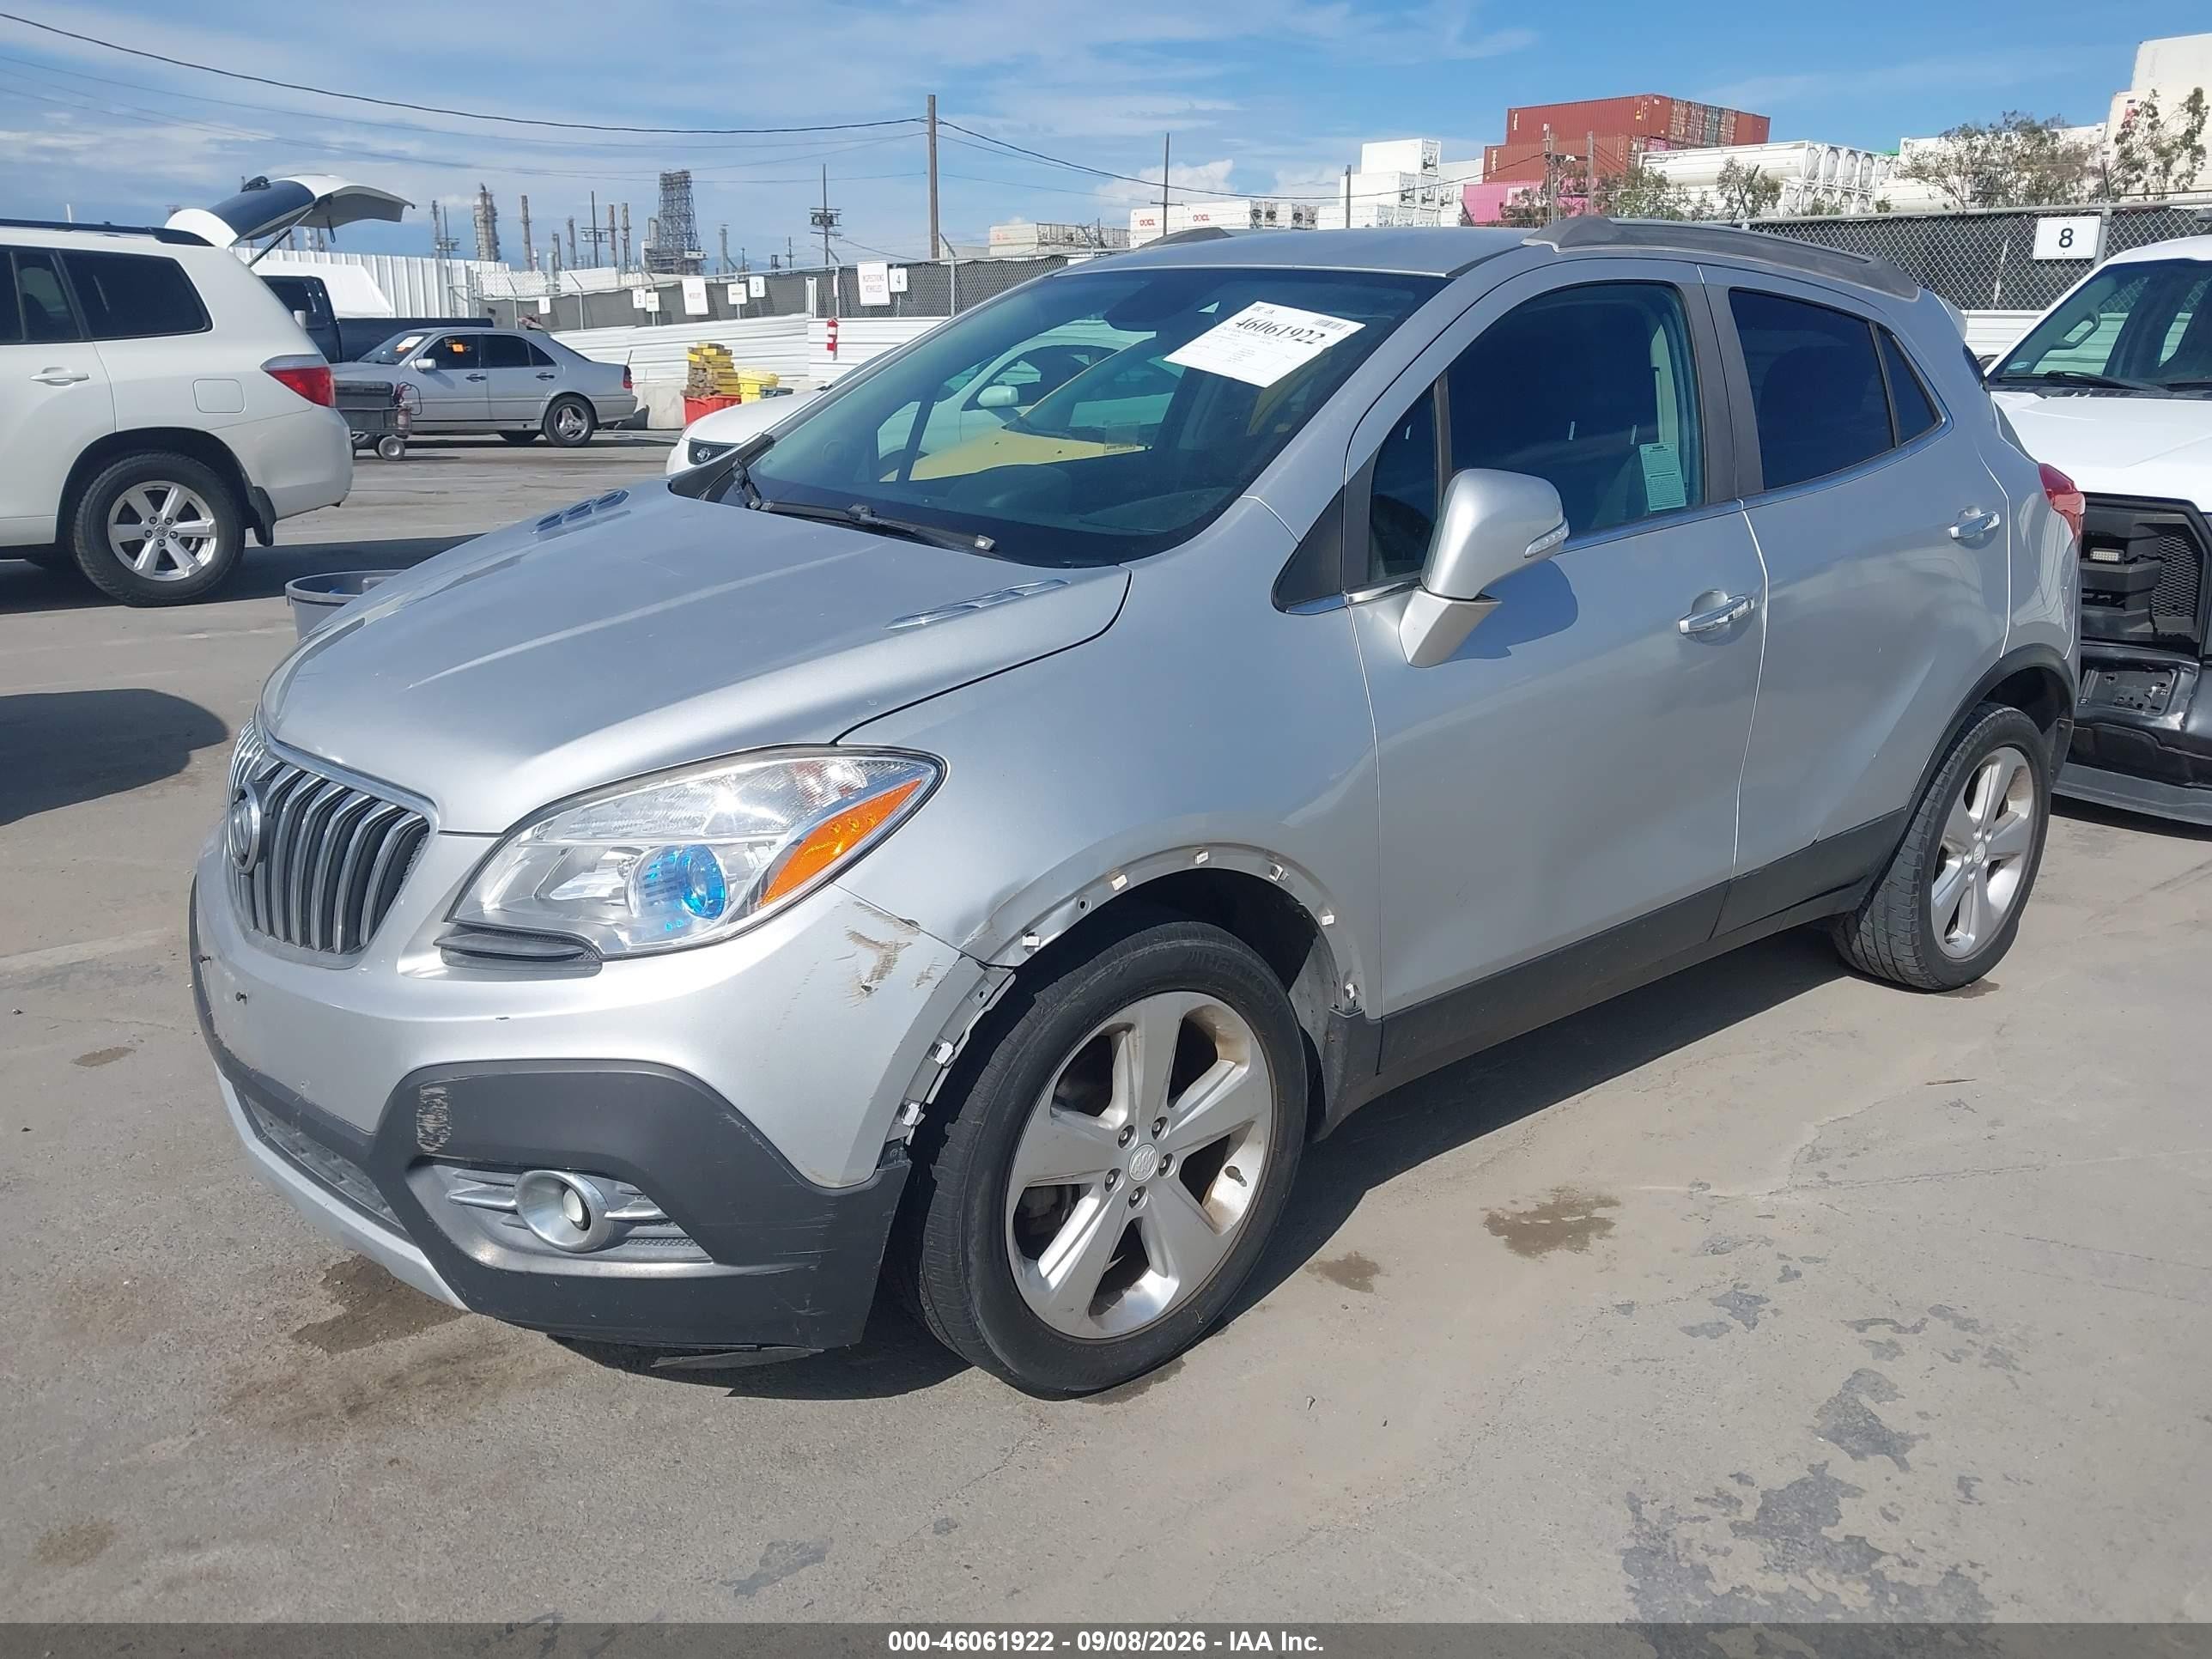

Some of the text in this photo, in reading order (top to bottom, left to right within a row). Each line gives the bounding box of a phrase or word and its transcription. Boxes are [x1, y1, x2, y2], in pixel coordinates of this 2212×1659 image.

[2058, 228, 2074, 248] 8
[896, 274, 902, 286] 4
[755, 281, 761, 292] 3
[636, 294, 642, 304] 2
[1236, 317, 1326, 345] 46061922
